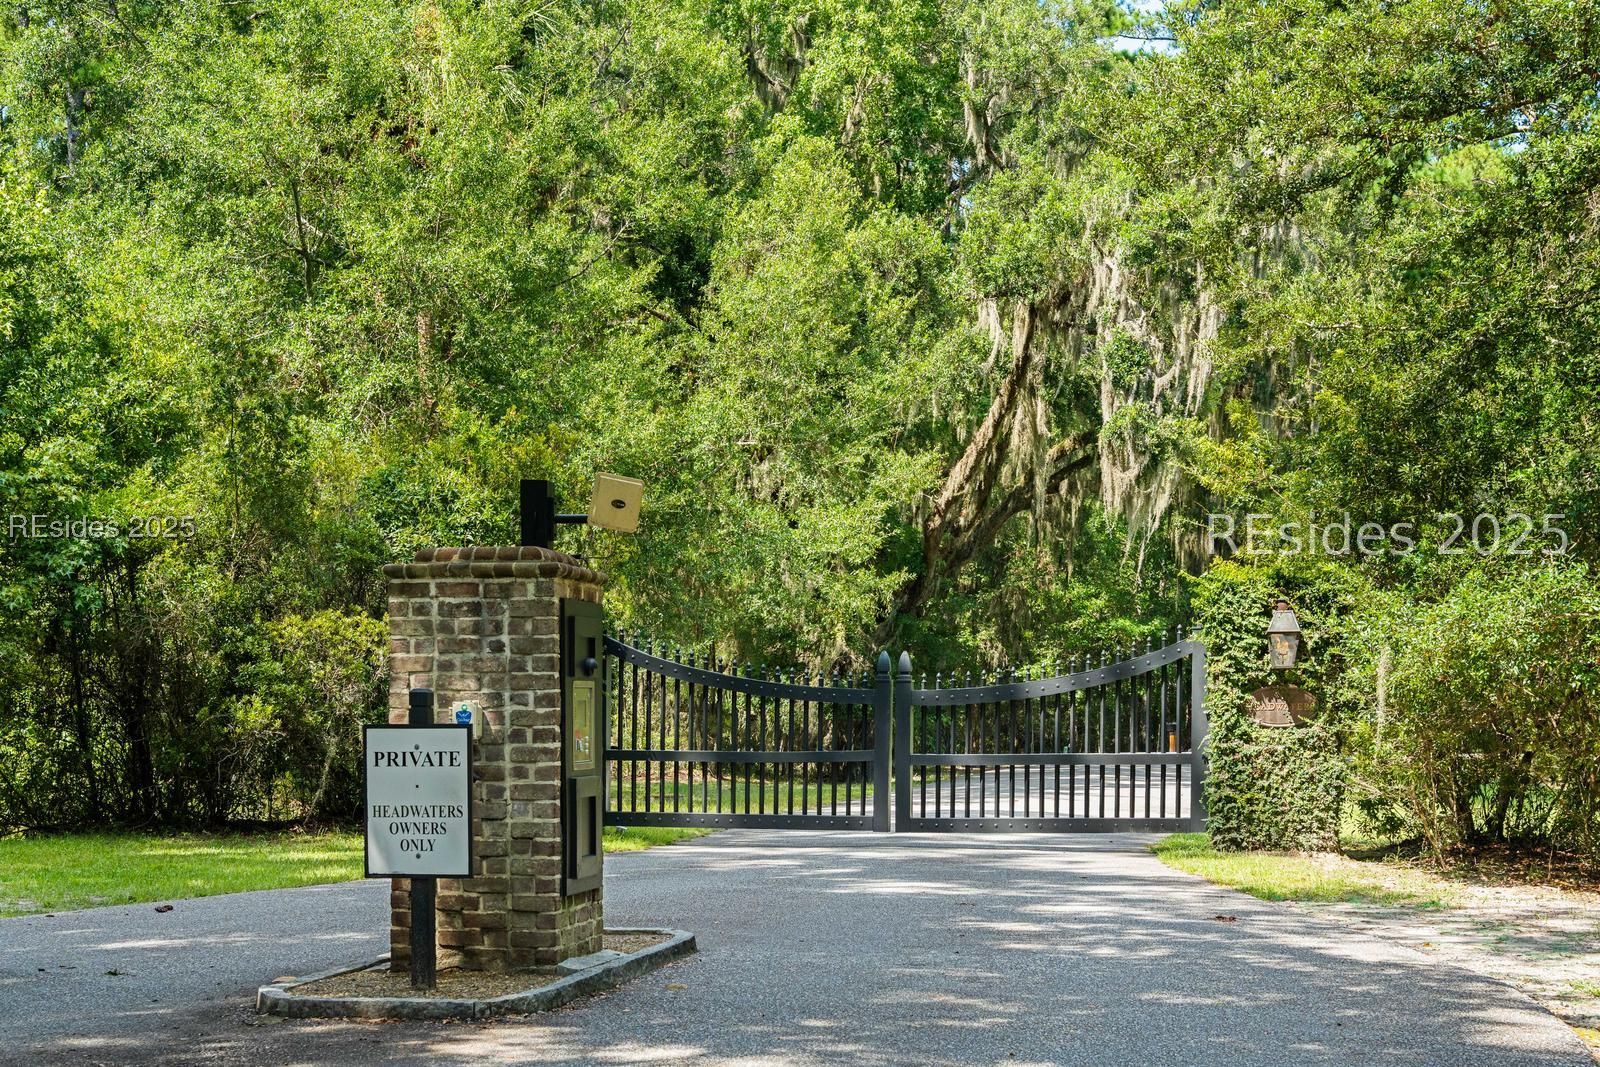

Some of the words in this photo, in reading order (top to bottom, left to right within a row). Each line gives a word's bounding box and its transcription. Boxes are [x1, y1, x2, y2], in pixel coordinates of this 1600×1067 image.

[1249, 702, 1315, 712] EADWATER
[374, 751, 461, 767] PRIVATE
[372, 805, 464, 818] HEADWATERS
[389, 822, 446, 835] OWNERS
[400, 838, 436, 852] ONLY
